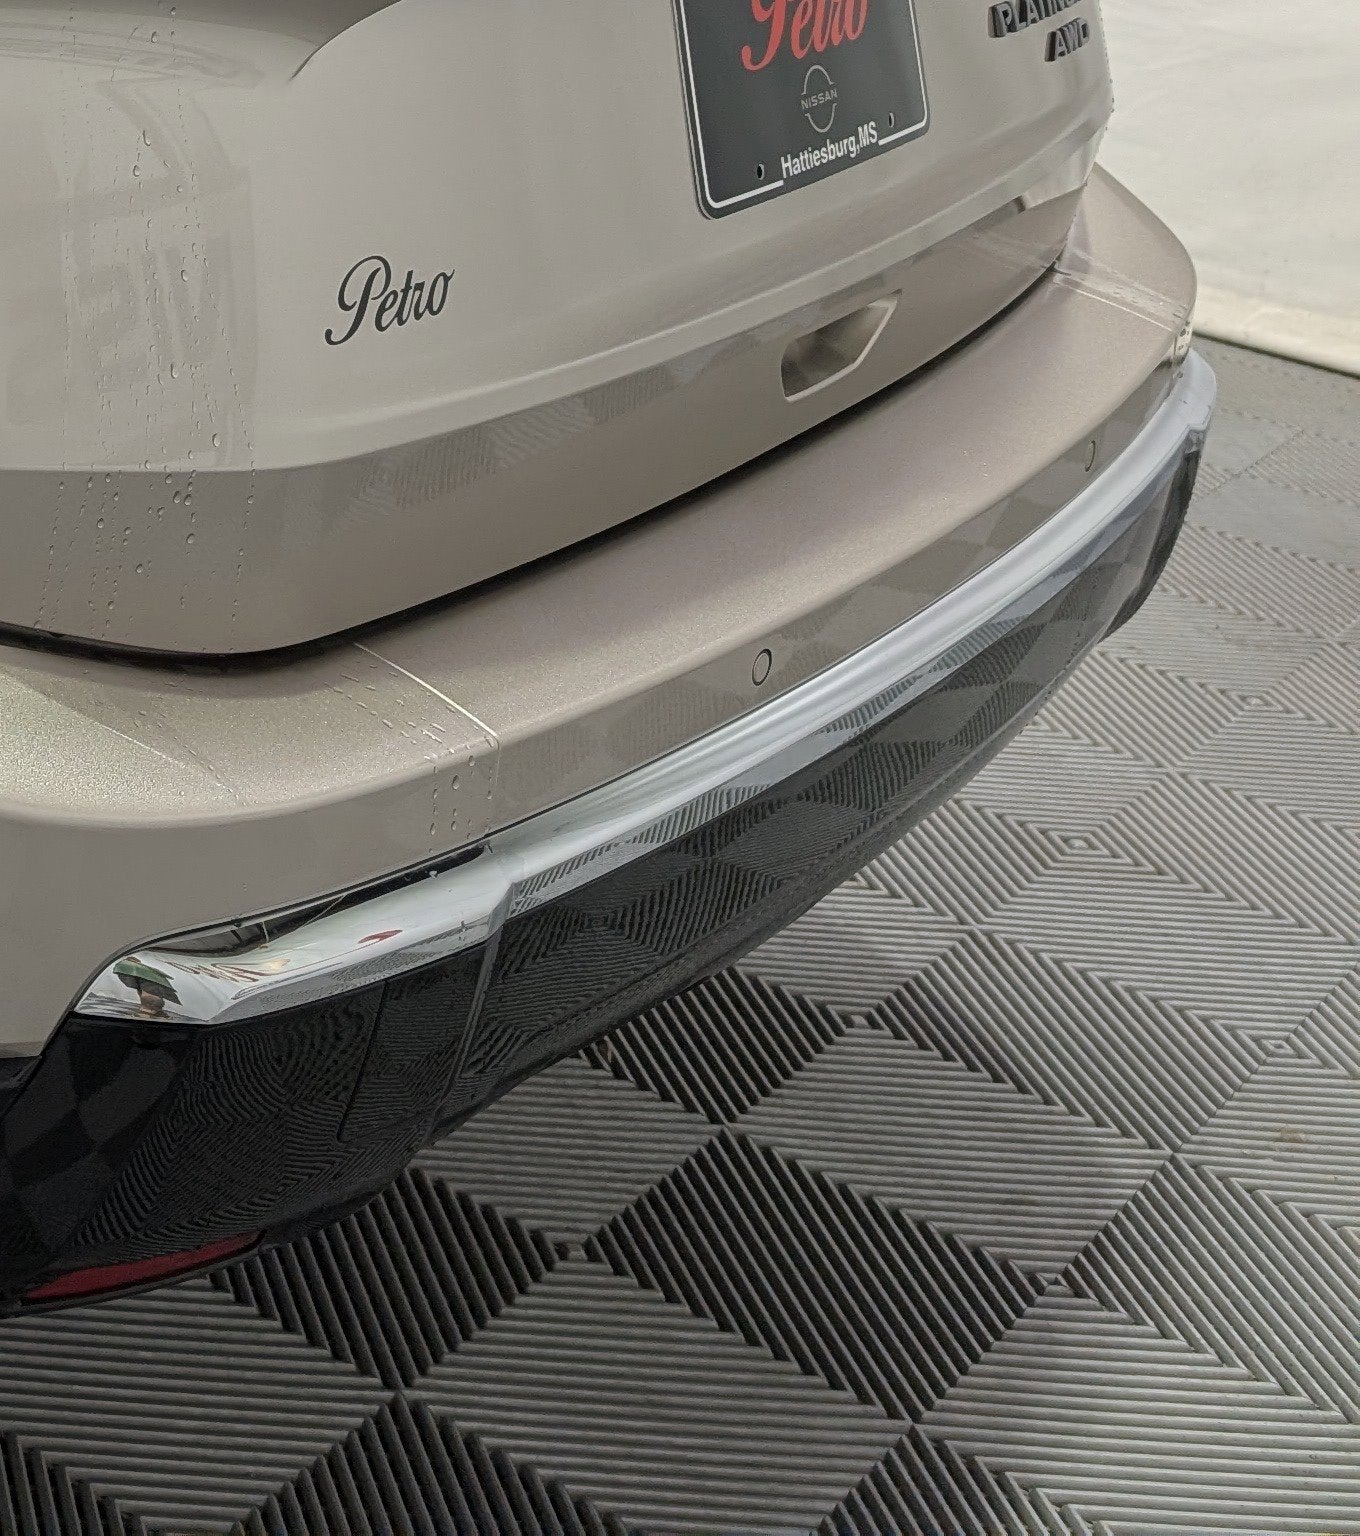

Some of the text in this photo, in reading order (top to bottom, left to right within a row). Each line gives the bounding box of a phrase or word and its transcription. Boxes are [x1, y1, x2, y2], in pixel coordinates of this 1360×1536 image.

[1044, 17, 1090, 62] AWD
[801, 88, 838, 110] NISSAN
[324, 255, 455, 346] Petro
